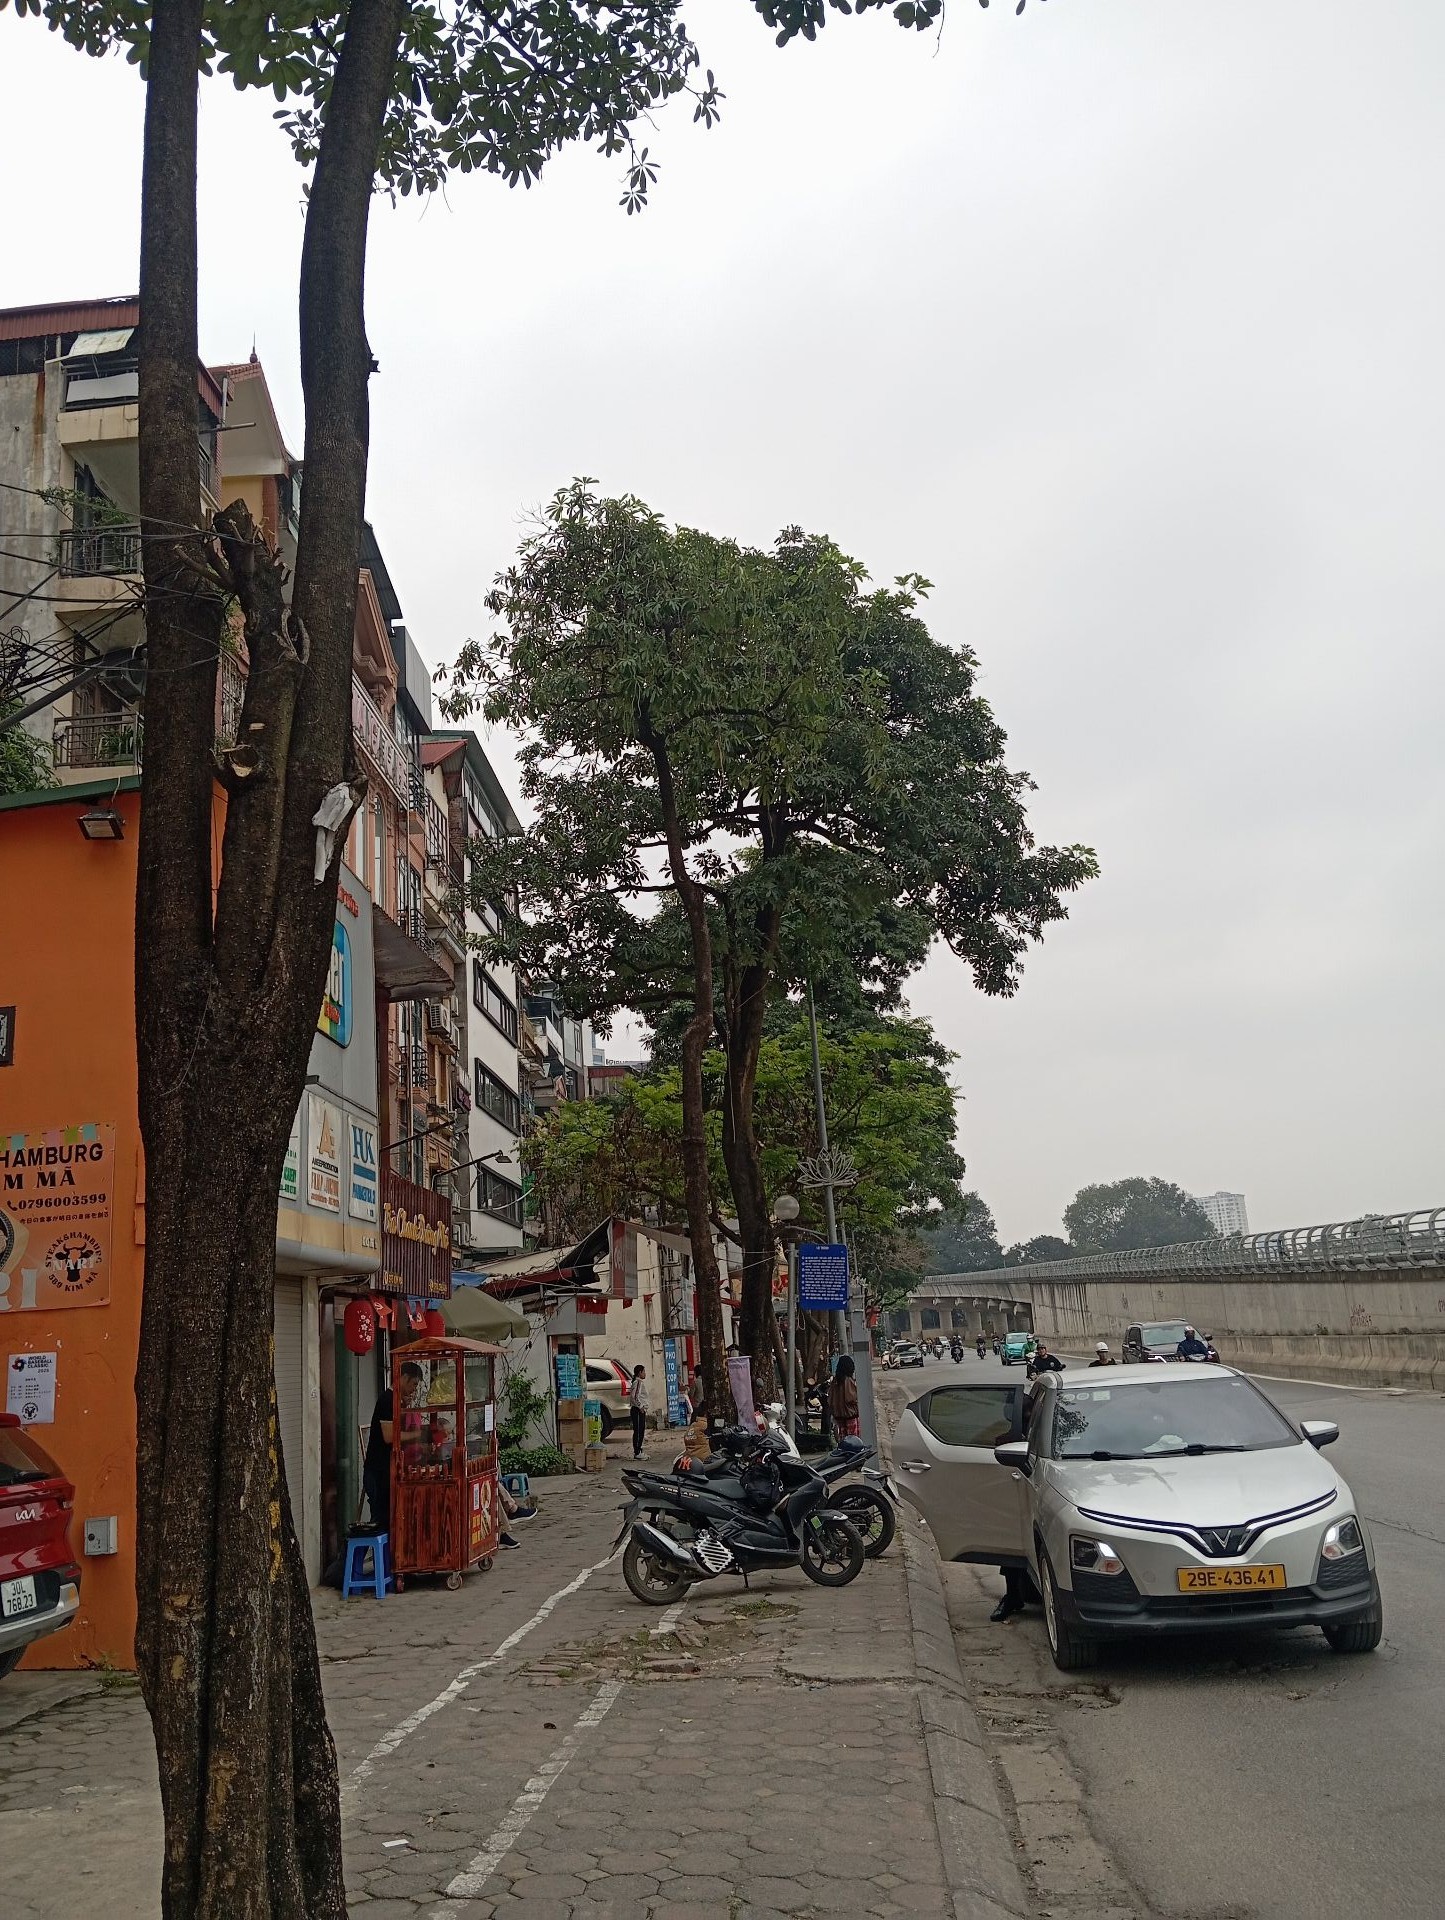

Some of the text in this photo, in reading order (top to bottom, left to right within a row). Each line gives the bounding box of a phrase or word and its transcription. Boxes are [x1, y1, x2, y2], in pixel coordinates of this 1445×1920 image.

[36, 1166, 76, 1188] MÃ
[18, 1193, 107, 1210] 0796003599
[64, 1283, 84, 1292] KIM
[667, 1362, 675, 1371] TO
[1187, 1569, 1276, 1588] 29E-436.41
[11, 1580, 27, 1596] 30L
[7, 1593, 34, 1614] 768.23
